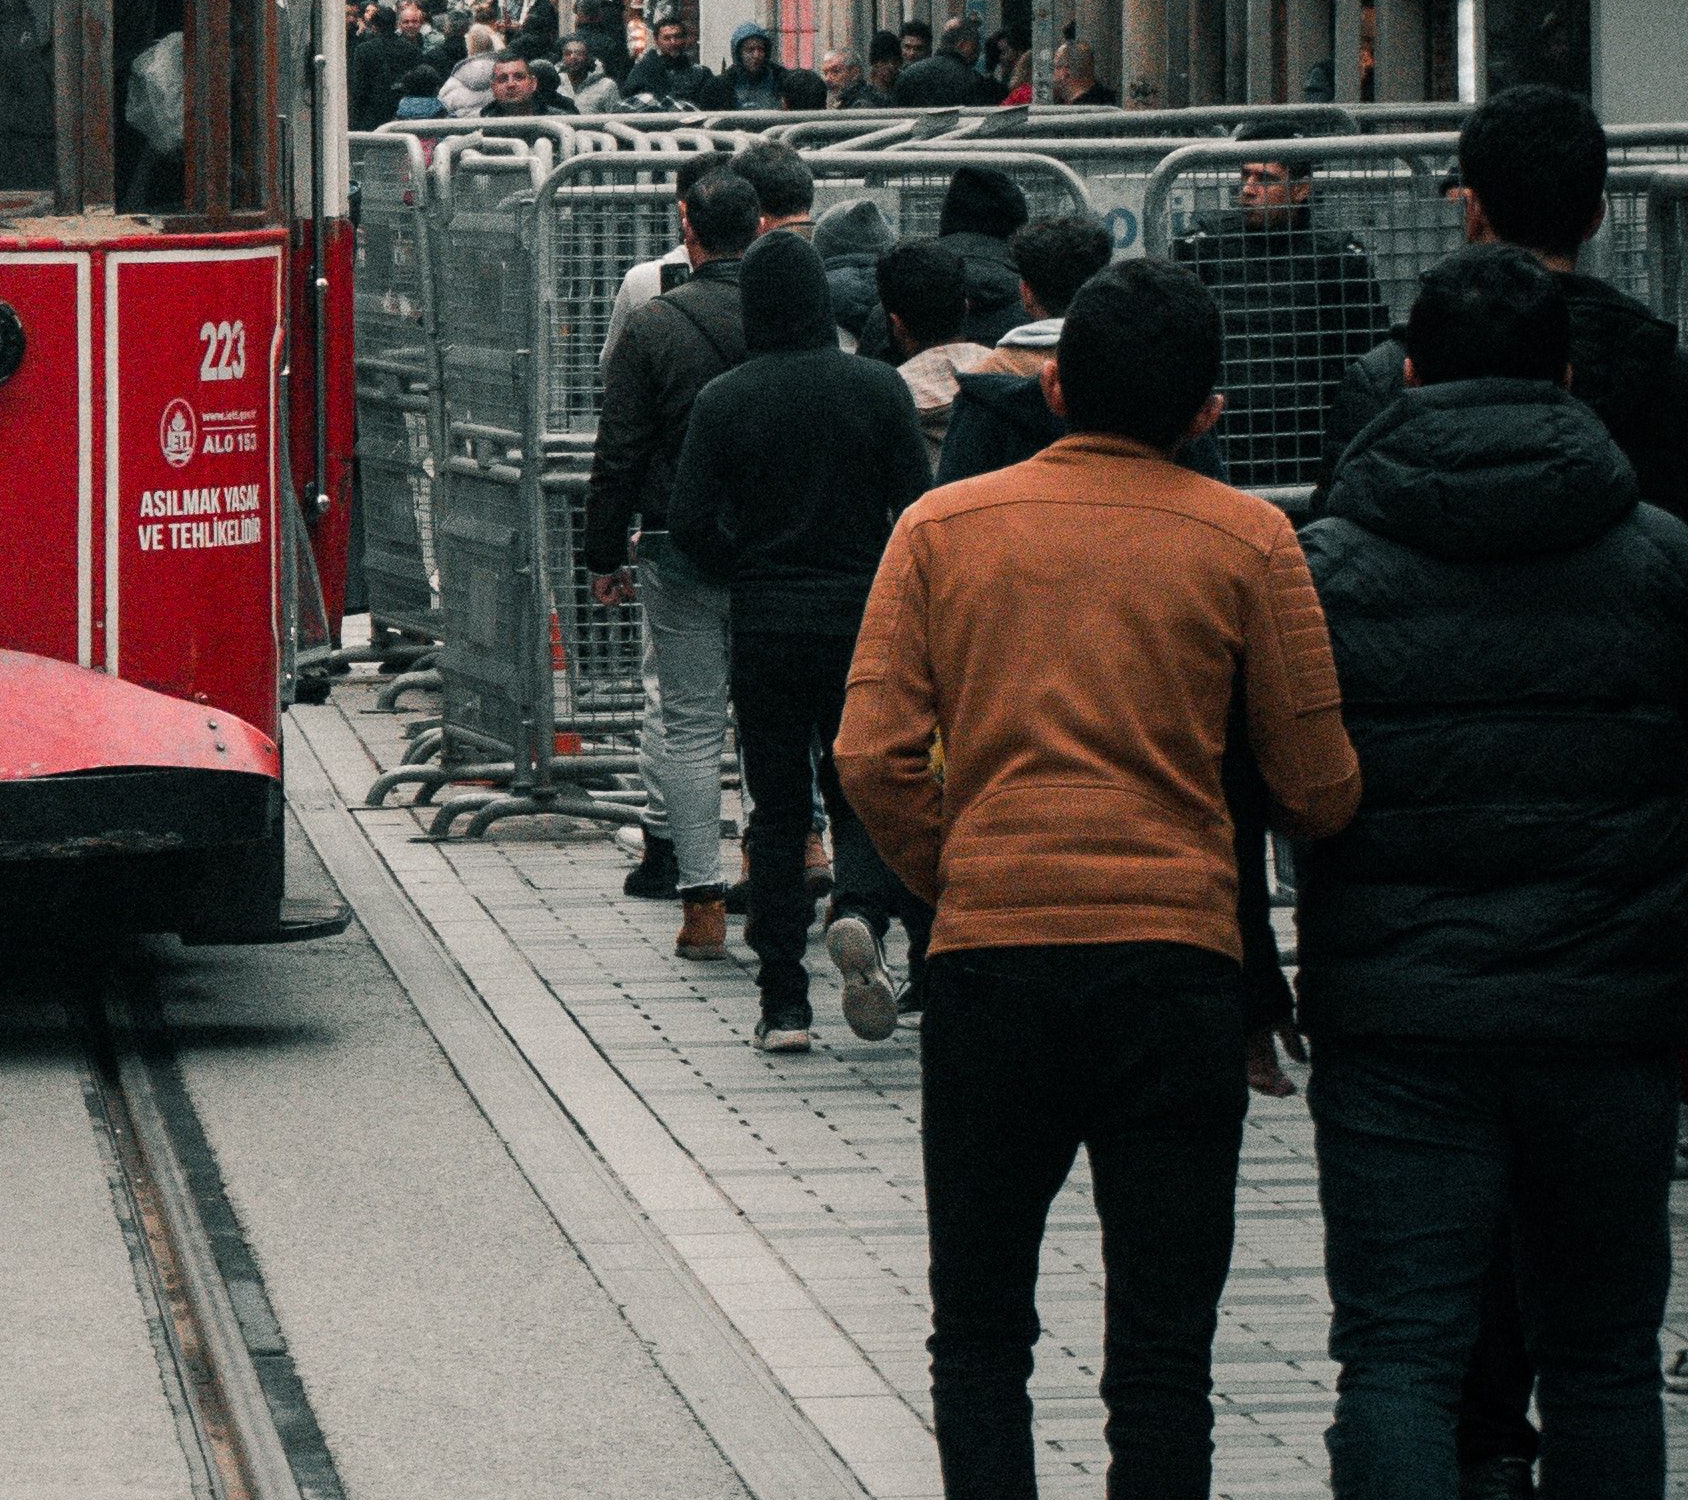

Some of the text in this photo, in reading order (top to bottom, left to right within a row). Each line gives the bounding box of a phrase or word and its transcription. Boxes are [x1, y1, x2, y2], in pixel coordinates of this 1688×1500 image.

[200, 319, 246, 382] 223
[202, 432, 257, 454] ALO 153
[140, 484, 259, 517] ASILMAK YASAK
[138, 514, 261, 550] VE TEHLİKELİDİR
